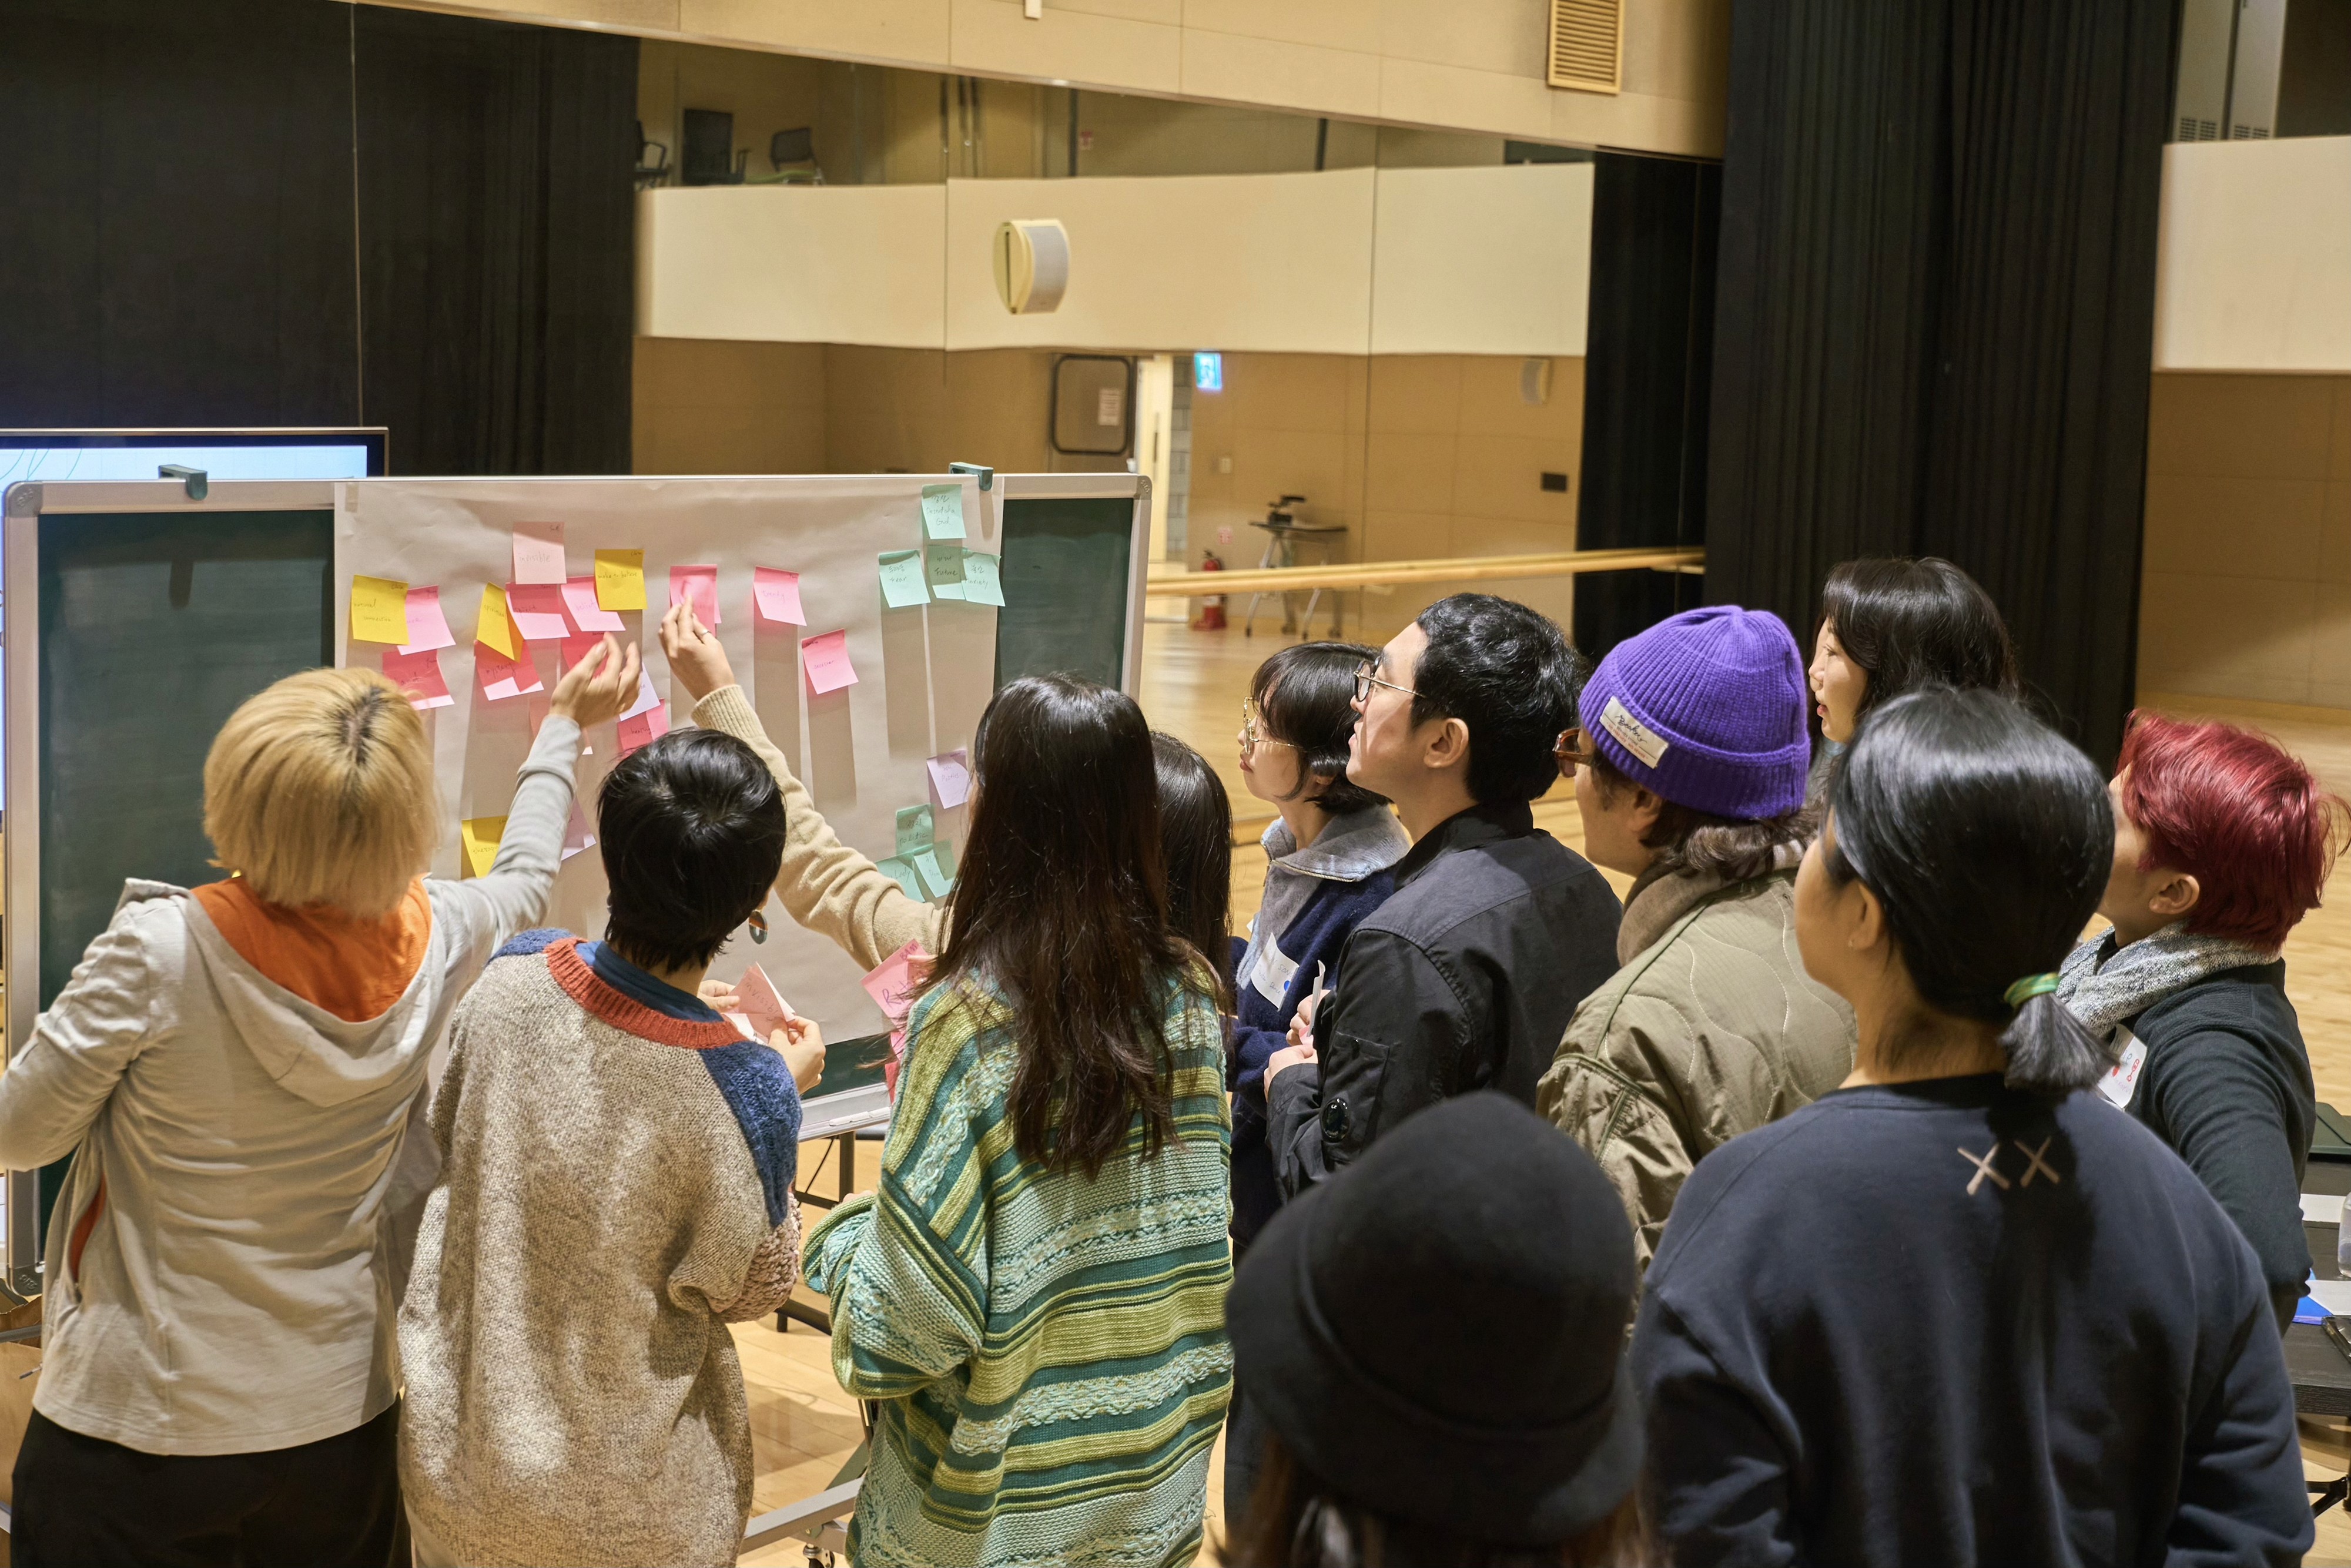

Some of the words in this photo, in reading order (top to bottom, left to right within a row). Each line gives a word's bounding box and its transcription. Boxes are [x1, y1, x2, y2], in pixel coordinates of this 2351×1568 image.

[518, 551, 551, 563] invisible
[934, 567, 959, 577] Future
[485, 662, 517, 679] mystery
